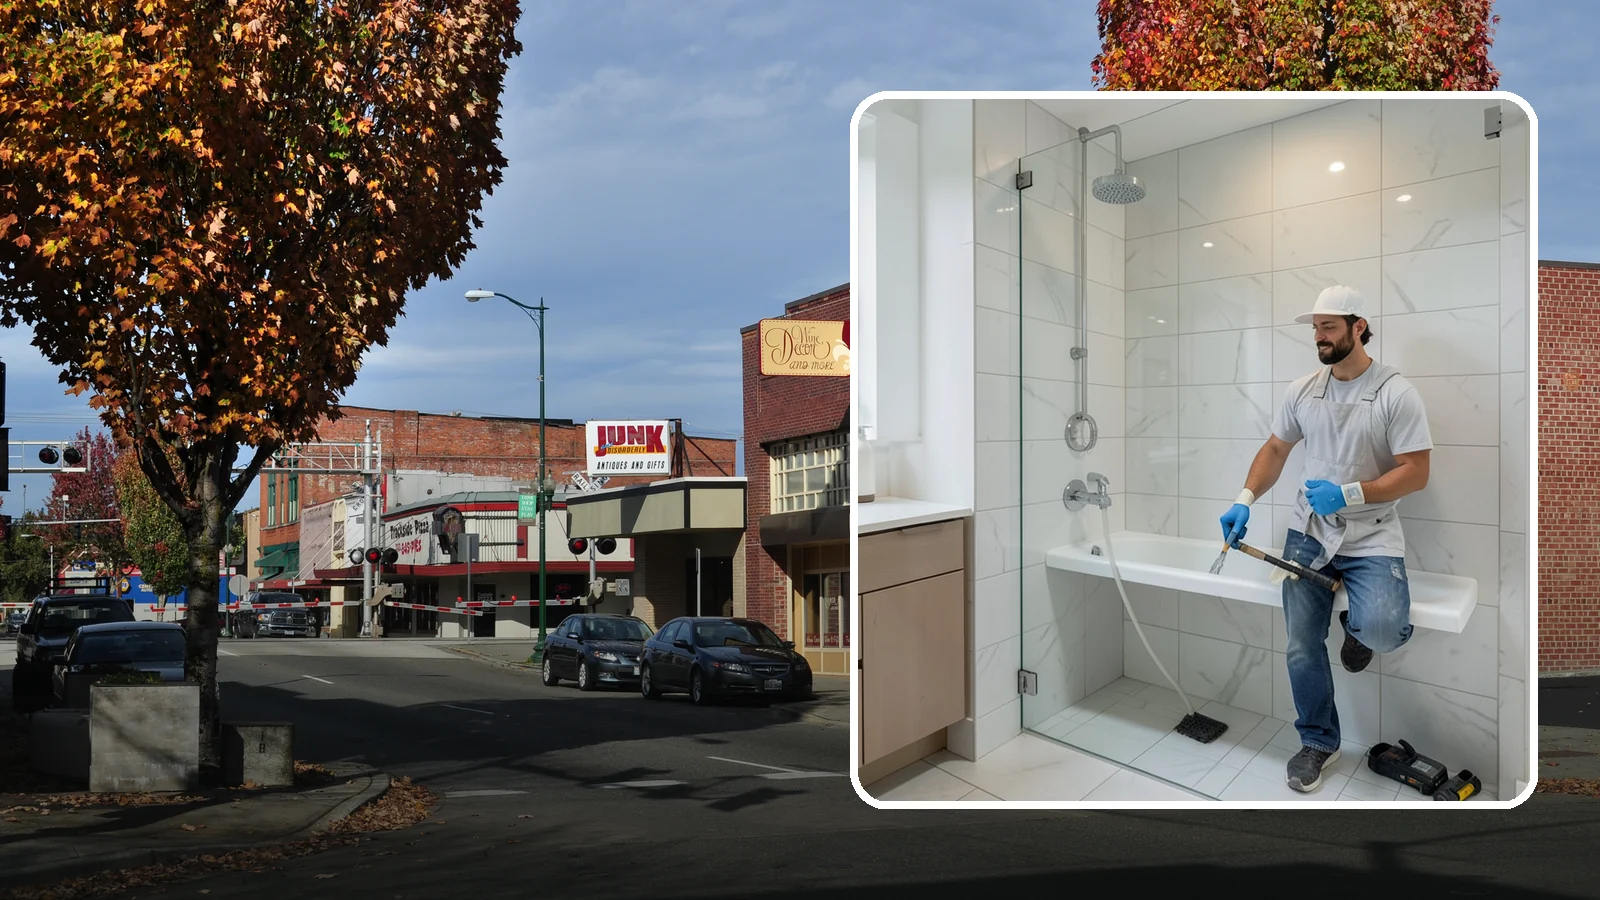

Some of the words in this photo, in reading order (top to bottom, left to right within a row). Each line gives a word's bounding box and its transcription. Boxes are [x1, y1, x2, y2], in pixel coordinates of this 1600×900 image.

[595, 425, 666, 457] JUNK
[607, 446, 646, 454] DISORDERLY
[596, 461, 628, 470] ANTIQUES
[631, 461, 644, 470] AND
[647, 460, 665, 470] GIFTS
[573, 473, 588, 489] RAIL
[390, 521, 413, 540] Trackside
[415, 519, 429, 535] Pizza
